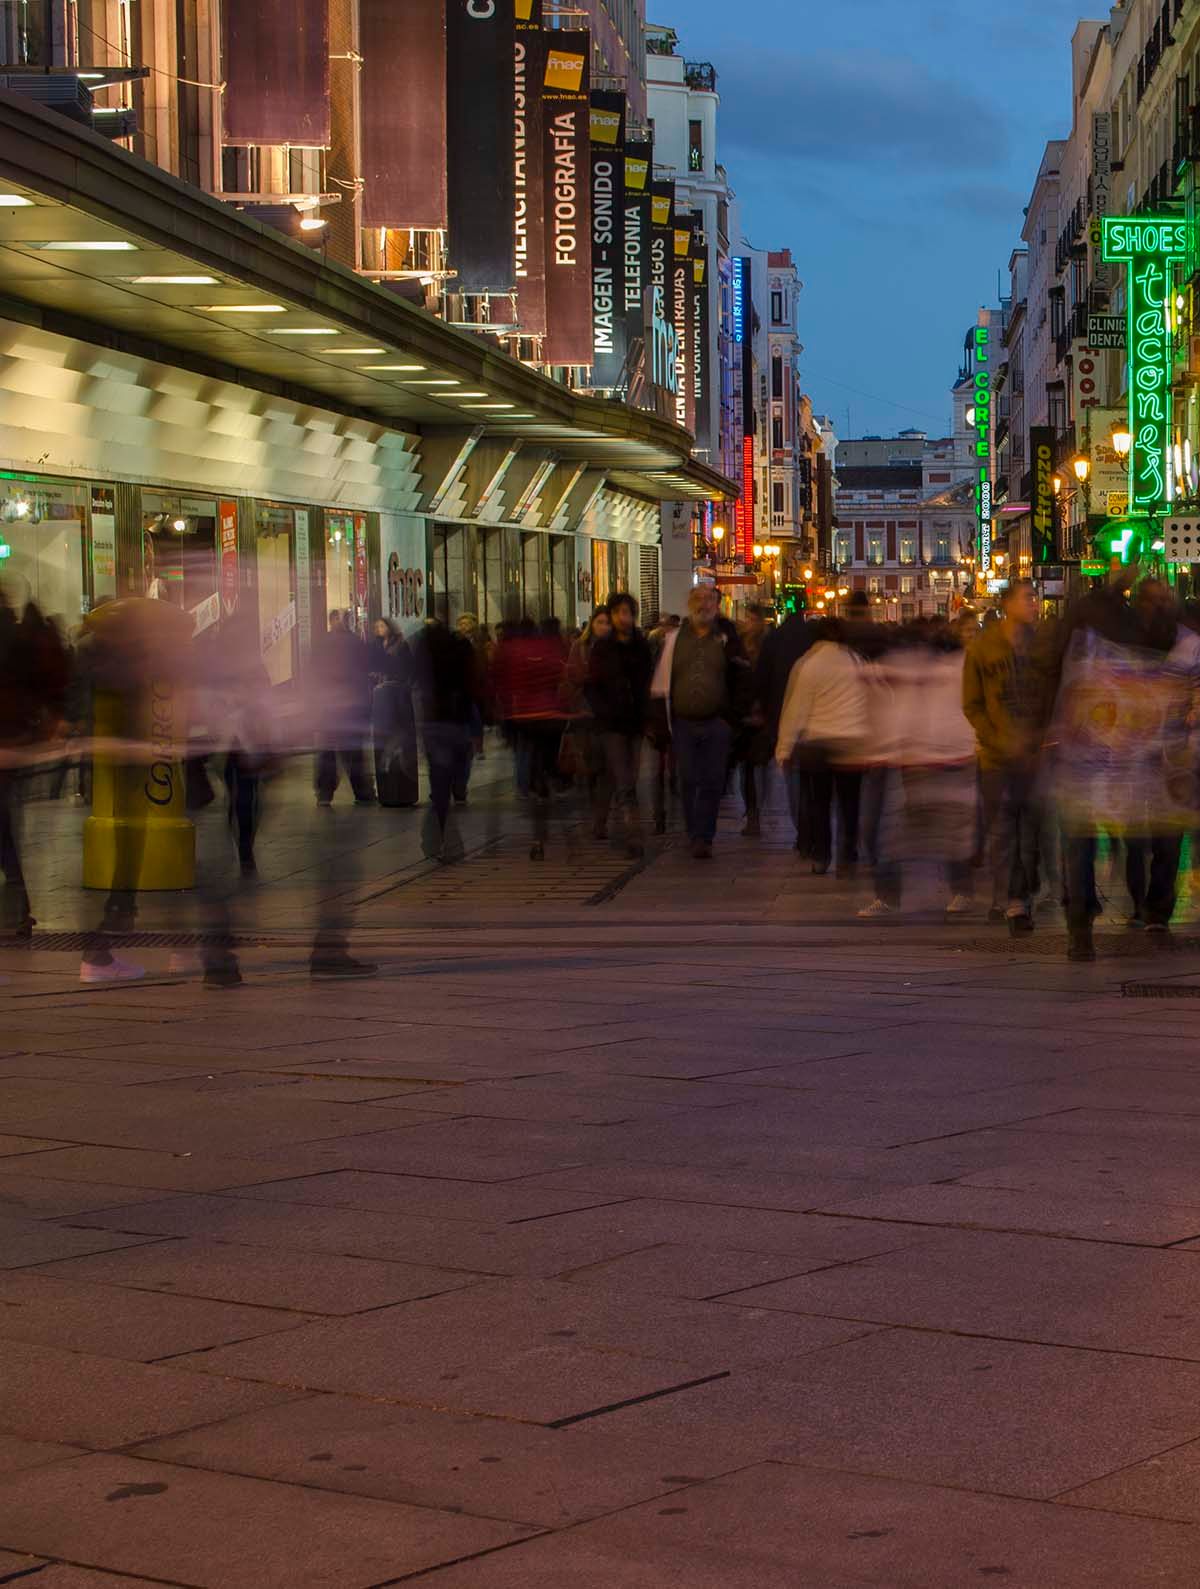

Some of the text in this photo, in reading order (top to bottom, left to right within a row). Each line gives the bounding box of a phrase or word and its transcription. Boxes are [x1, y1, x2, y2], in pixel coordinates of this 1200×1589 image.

[466, 0, 496, 19] C
[547, 57, 584, 71] fnac
[625, 163, 648, 173] nac
[549, 111, 577, 265] FOTOGRAFÍA
[593, 161, 613, 245] SONIDO
[1110, 225, 1195, 252] SHOES
[624, 205, 641, 312] TELEFONIA
[593, 266, 614, 354] IMAGEN
[1089, 319, 1126, 331] CLINIC
[975, 328, 989, 361] EL
[1089, 333, 1126, 346] DENTA
[1134, 262, 1165, 504] tacones
[974, 371, 990, 457] CORTE
[981, 481, 992, 520] 2000
[387, 551, 424, 617] fnac
